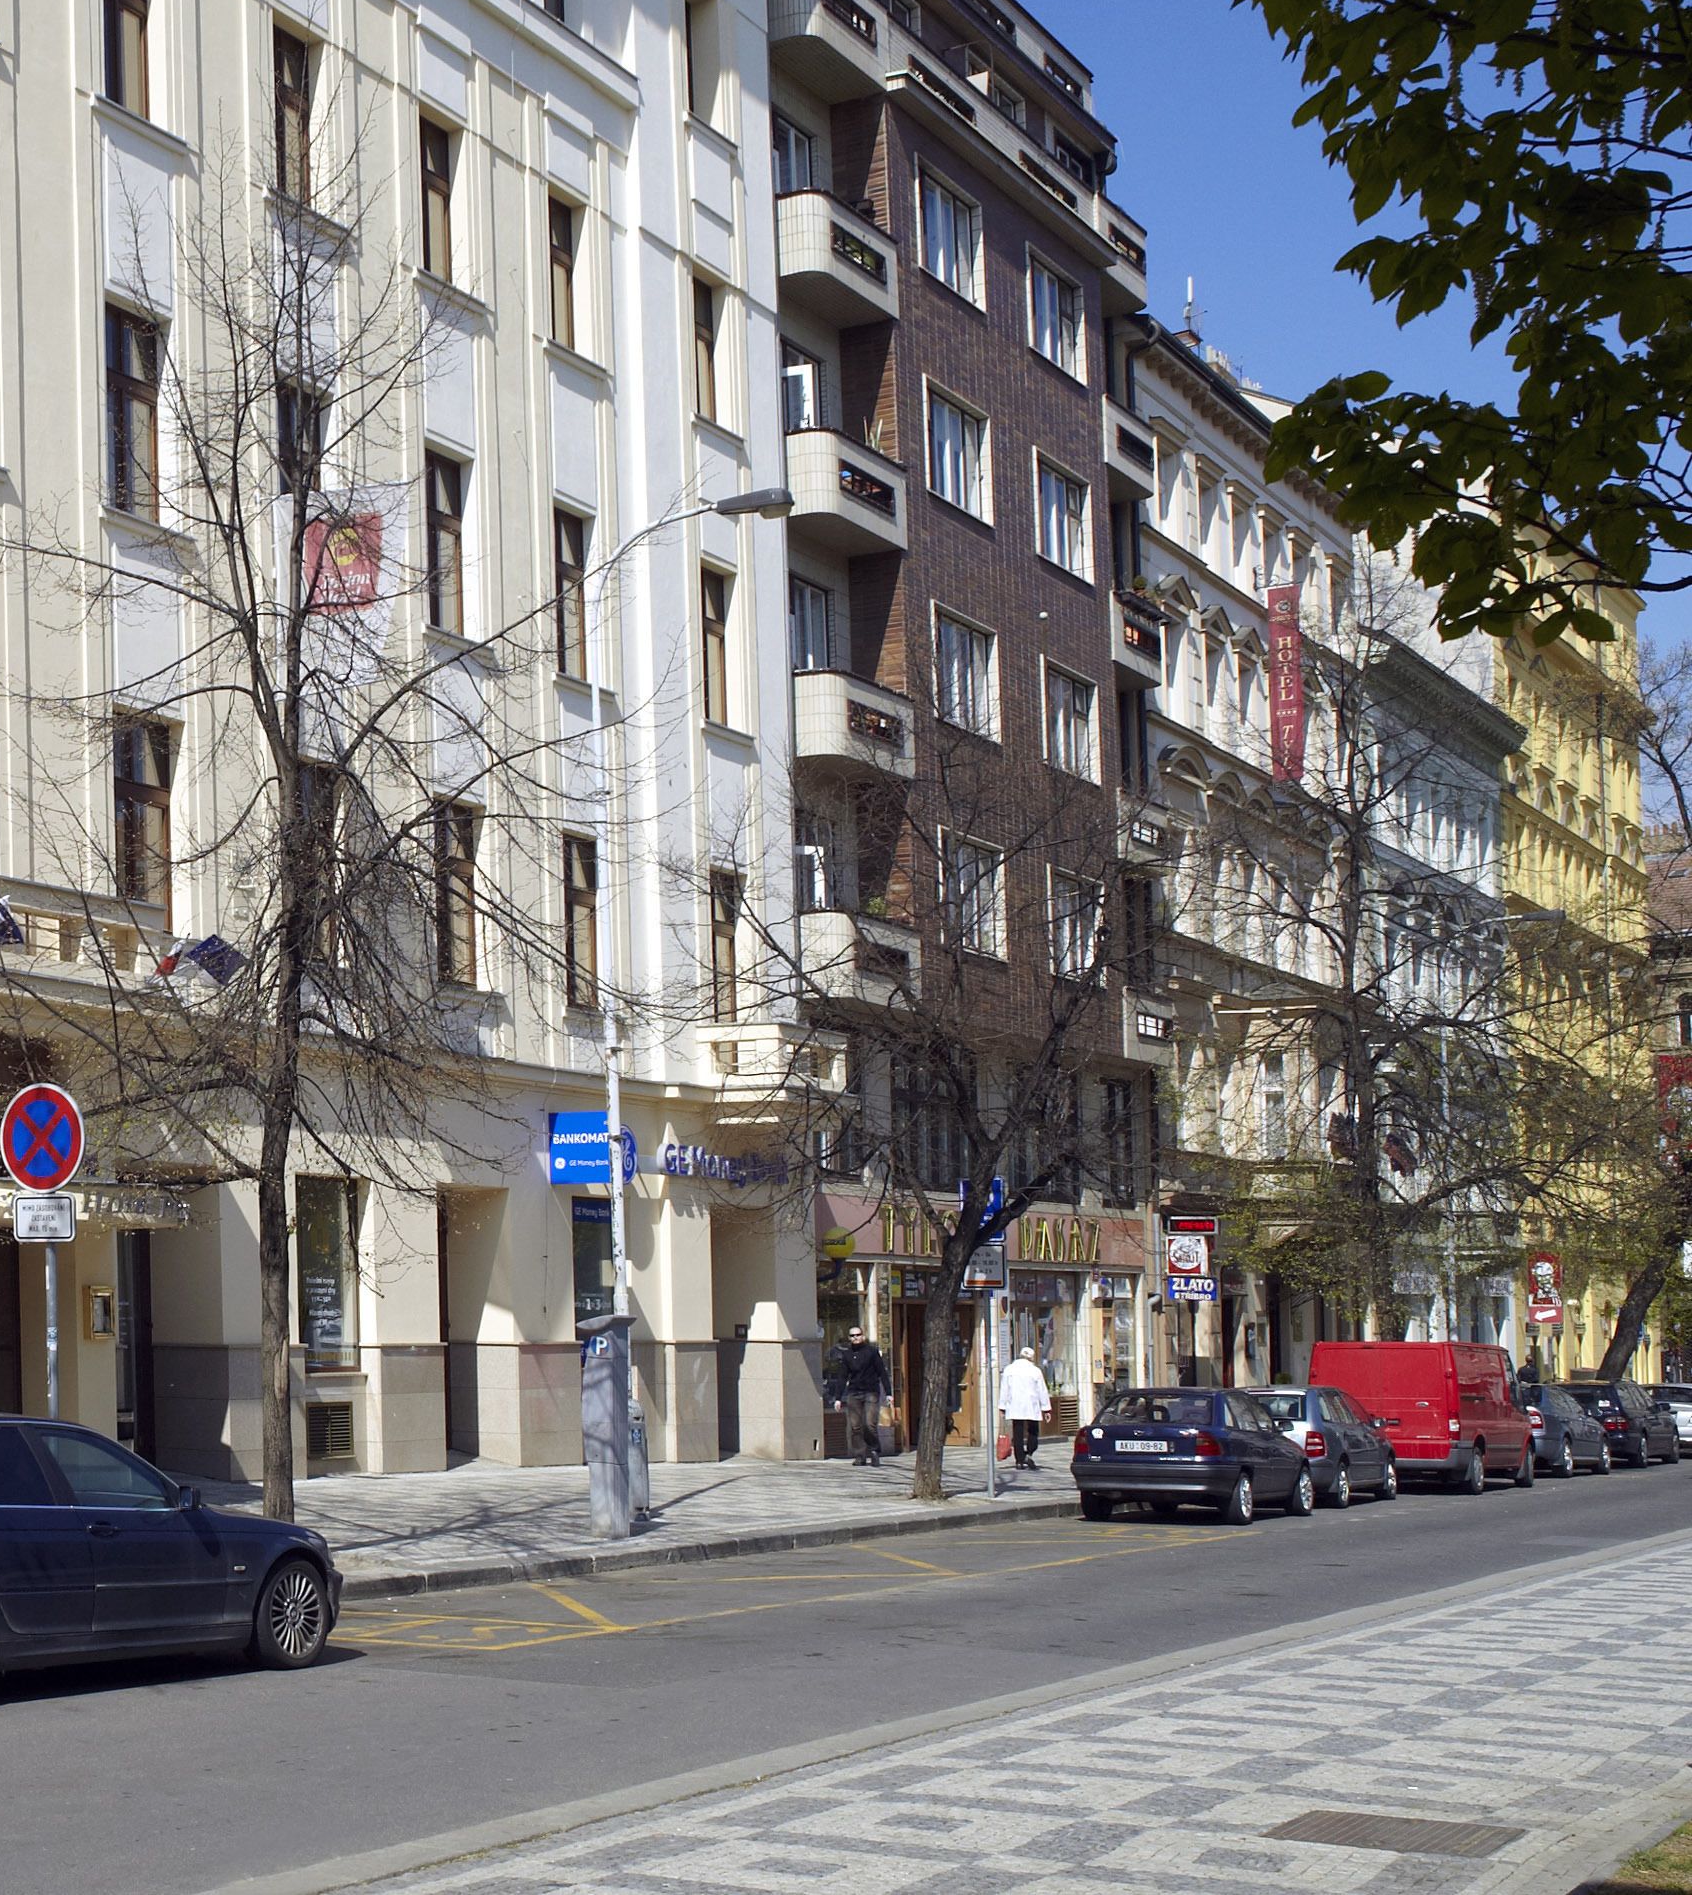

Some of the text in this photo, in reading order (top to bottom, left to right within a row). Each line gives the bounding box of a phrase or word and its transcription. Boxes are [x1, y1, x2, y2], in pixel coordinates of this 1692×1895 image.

[1276, 636, 1295, 701] HOTEL
[552, 1132, 609, 1145] BANKOMAT
[1171, 1277, 1214, 1292] ZLATO
